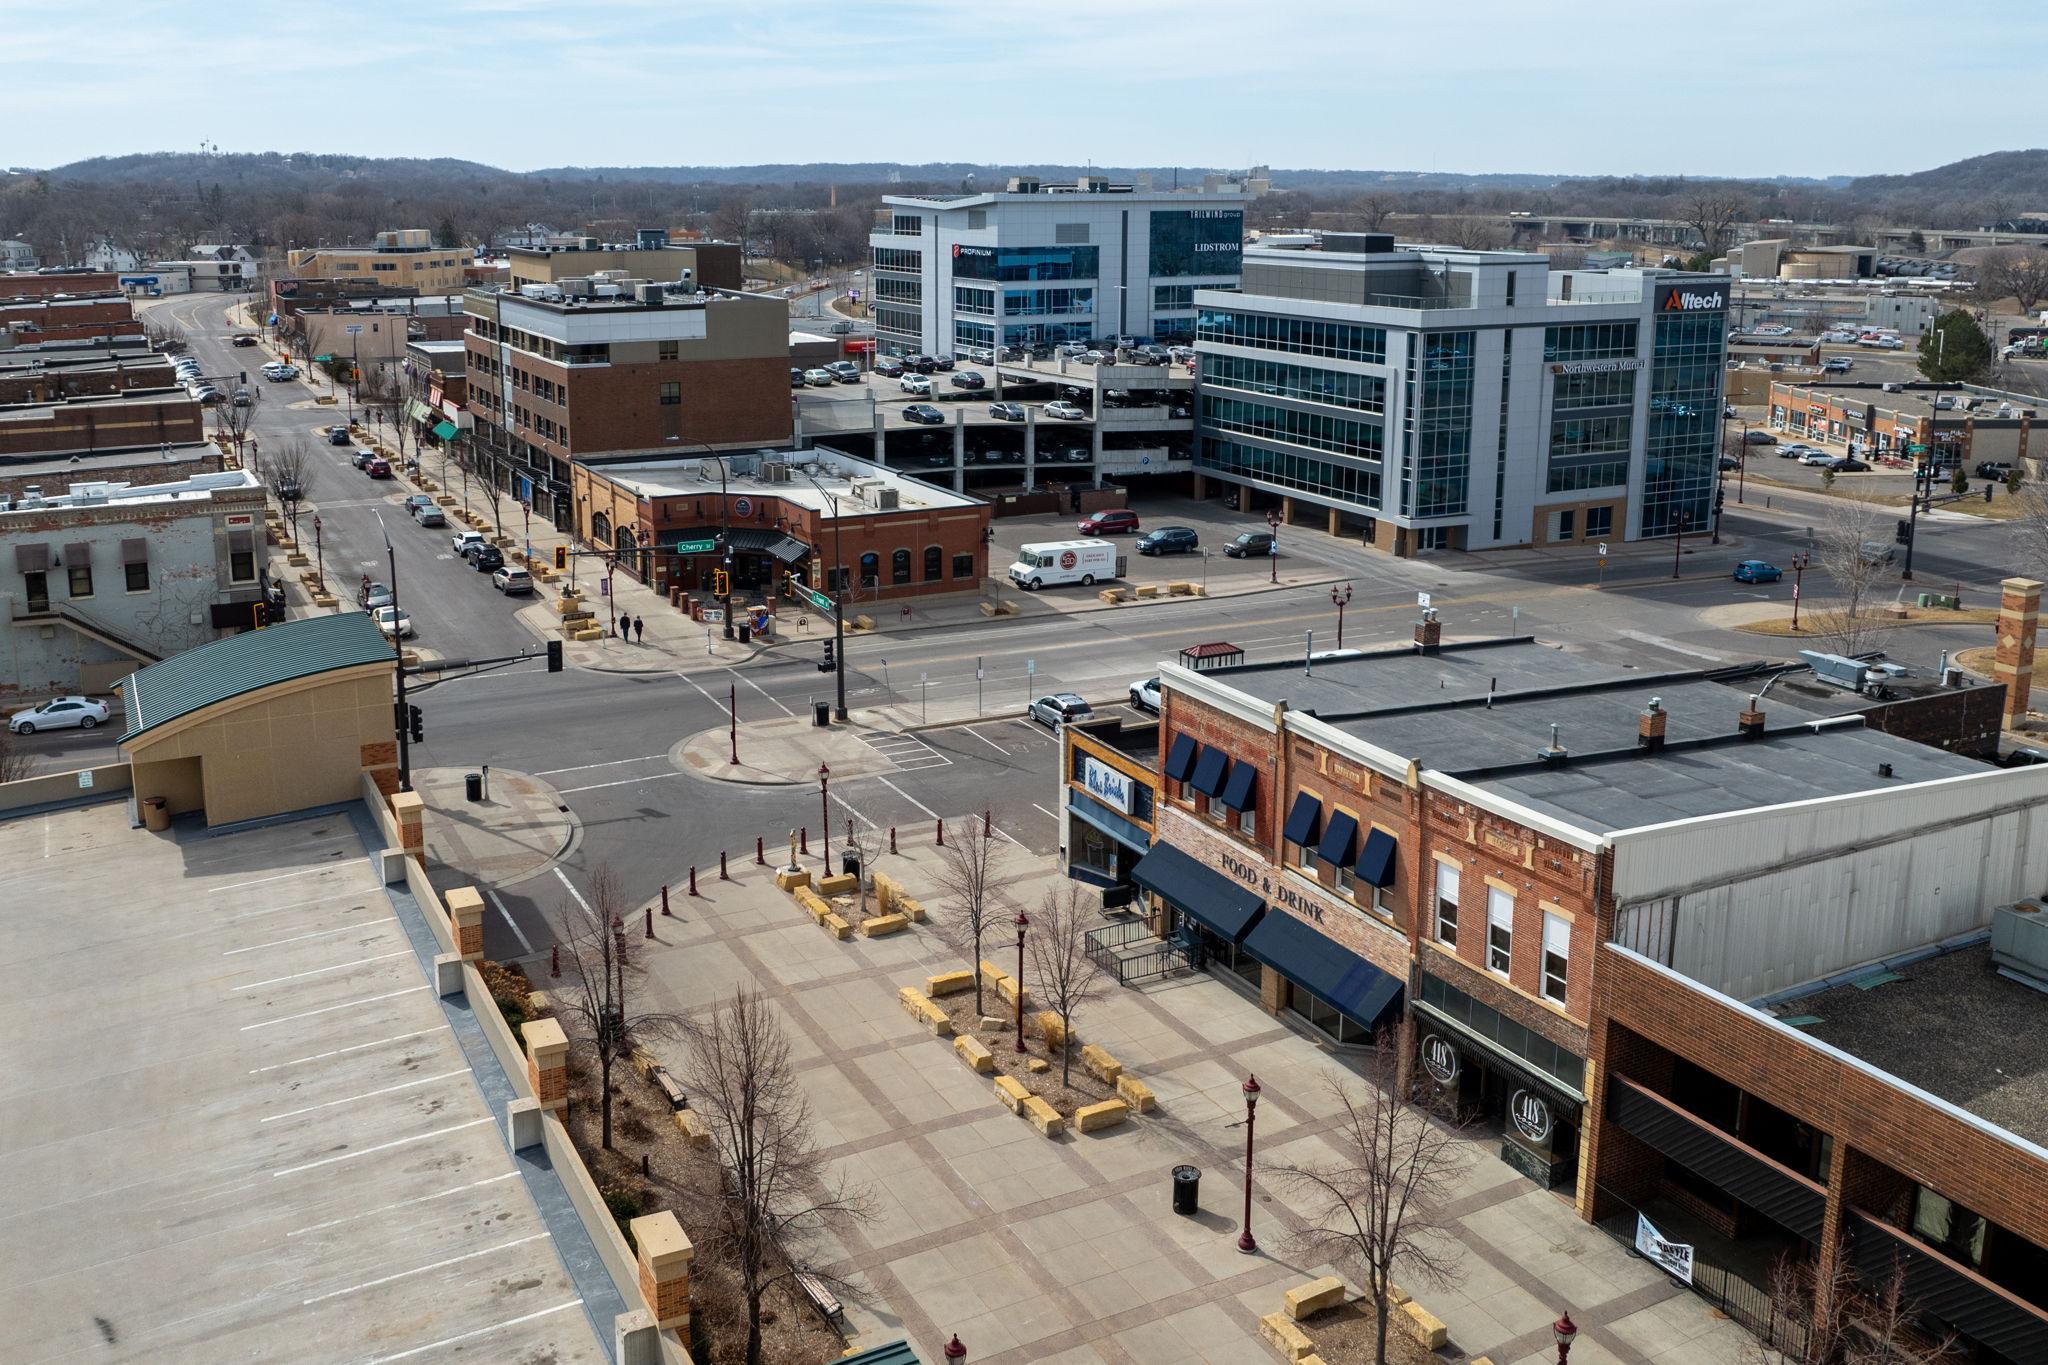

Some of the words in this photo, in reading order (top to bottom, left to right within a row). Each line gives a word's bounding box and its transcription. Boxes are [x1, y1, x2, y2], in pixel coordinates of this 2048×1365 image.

[960, 248, 992, 256] PROFINIUM
[1194, 242, 1239, 252] LIDSTROM
[1664, 288, 1722, 310] Alltech
[1562, 363, 1617, 374] Northwestern
[681, 543, 703, 551] Cherry
[1221, 853, 1257, 884] FOOD
[1262, 876, 1271, 895] &
[1276, 885, 1325, 925] DRINK
[1430, 1040, 1447, 1067] 418
[1521, 1095, 1540, 1124] 418
